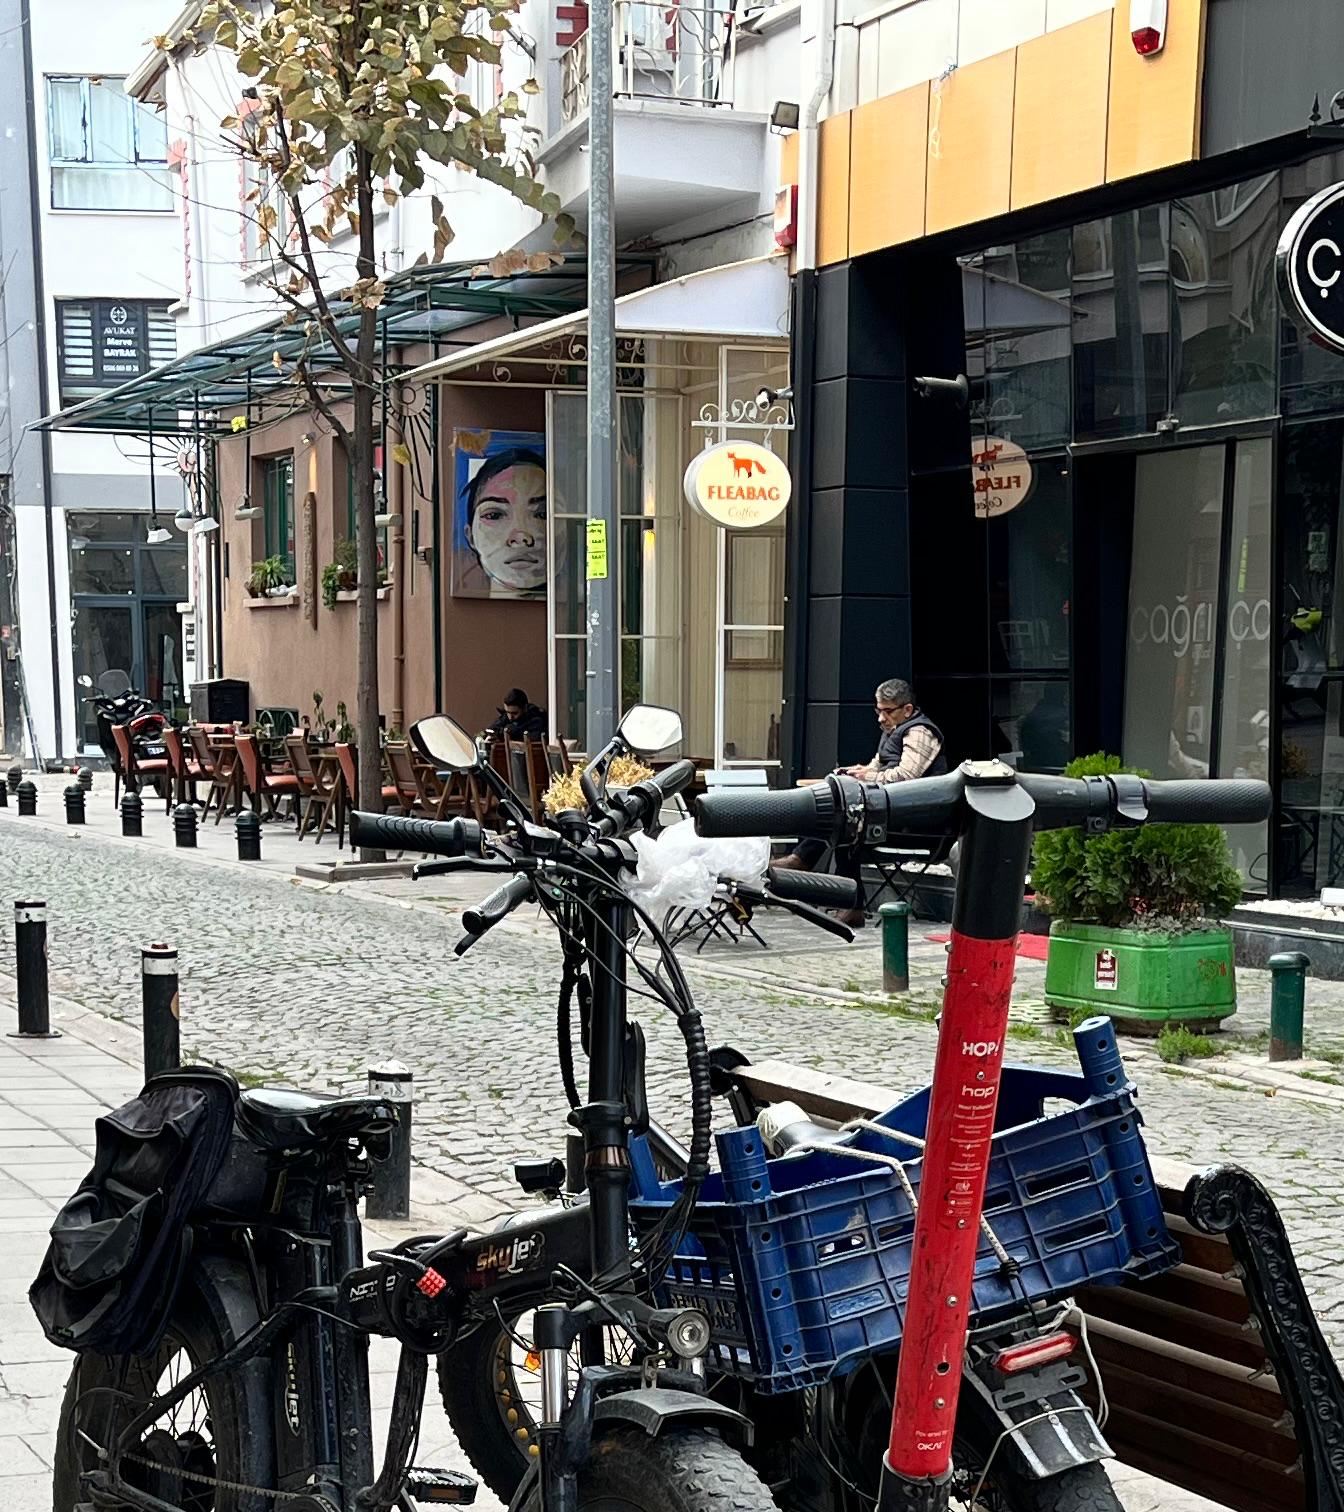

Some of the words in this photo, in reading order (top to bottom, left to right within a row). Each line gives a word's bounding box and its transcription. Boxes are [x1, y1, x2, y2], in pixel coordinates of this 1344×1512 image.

[103, 327, 136, 335] AVUKAT
[707, 485, 781, 501] FLEABAG
[962, 1036, 1002, 1057] HOP!
[961, 1085, 995, 1099] hop
